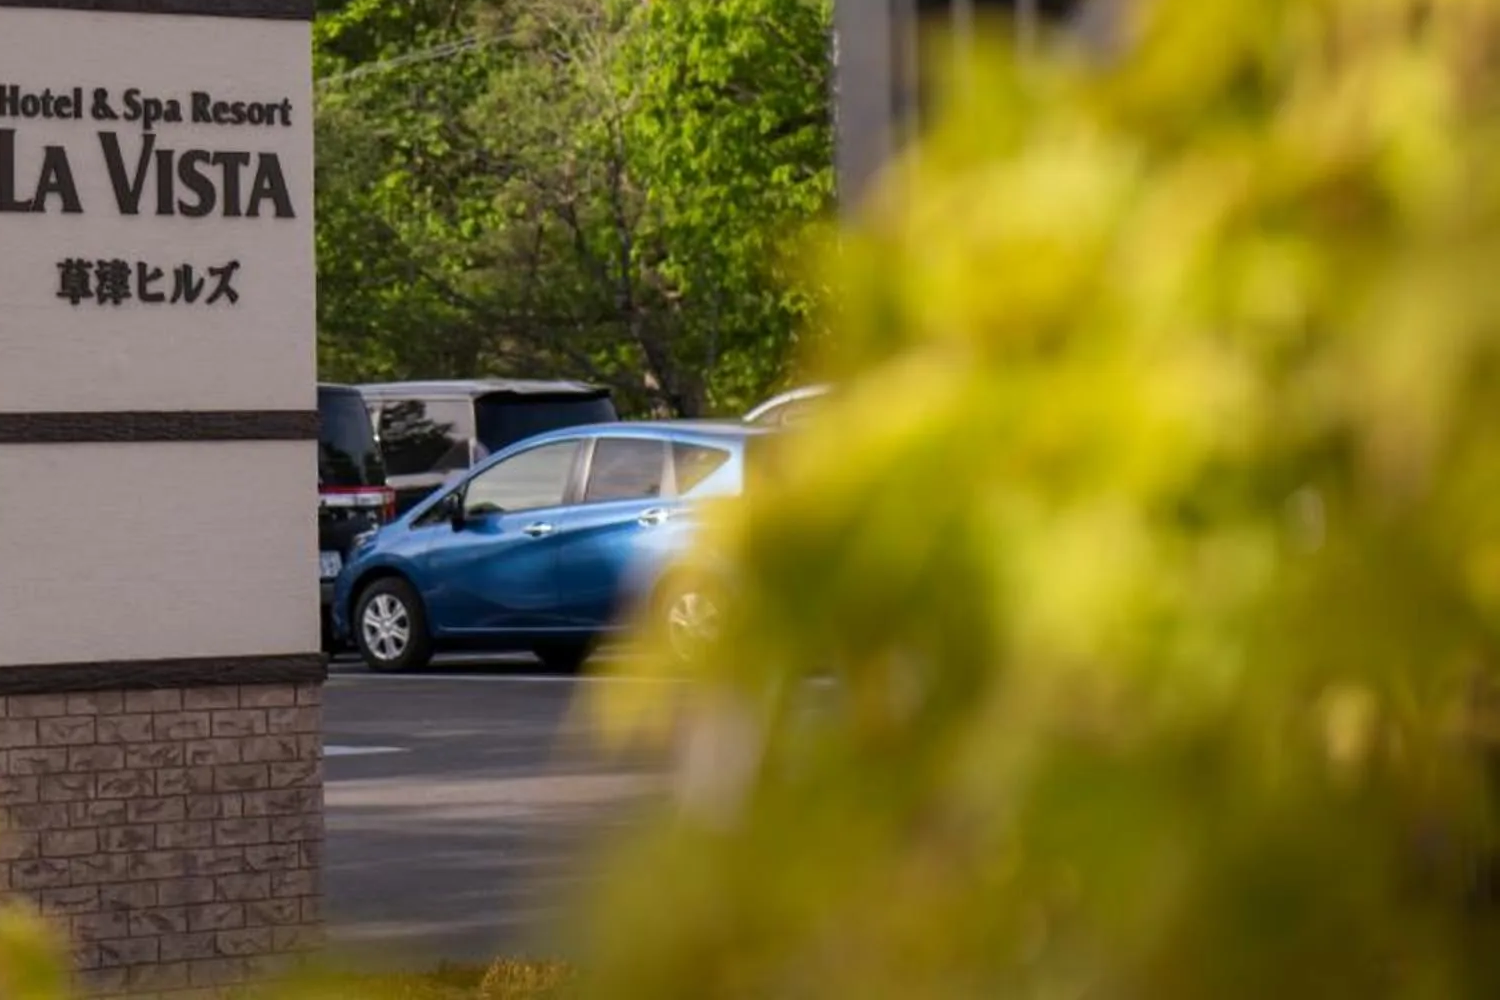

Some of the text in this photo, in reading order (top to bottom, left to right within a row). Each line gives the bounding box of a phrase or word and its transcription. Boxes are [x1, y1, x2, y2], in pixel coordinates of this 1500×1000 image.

[91, 88, 118, 120] &
[122, 88, 182, 130] Spa
[191, 91, 292, 127] Resort
[97, 131, 296, 218] VISTA
[56, 258, 241, 306] 草津ヒルズ
